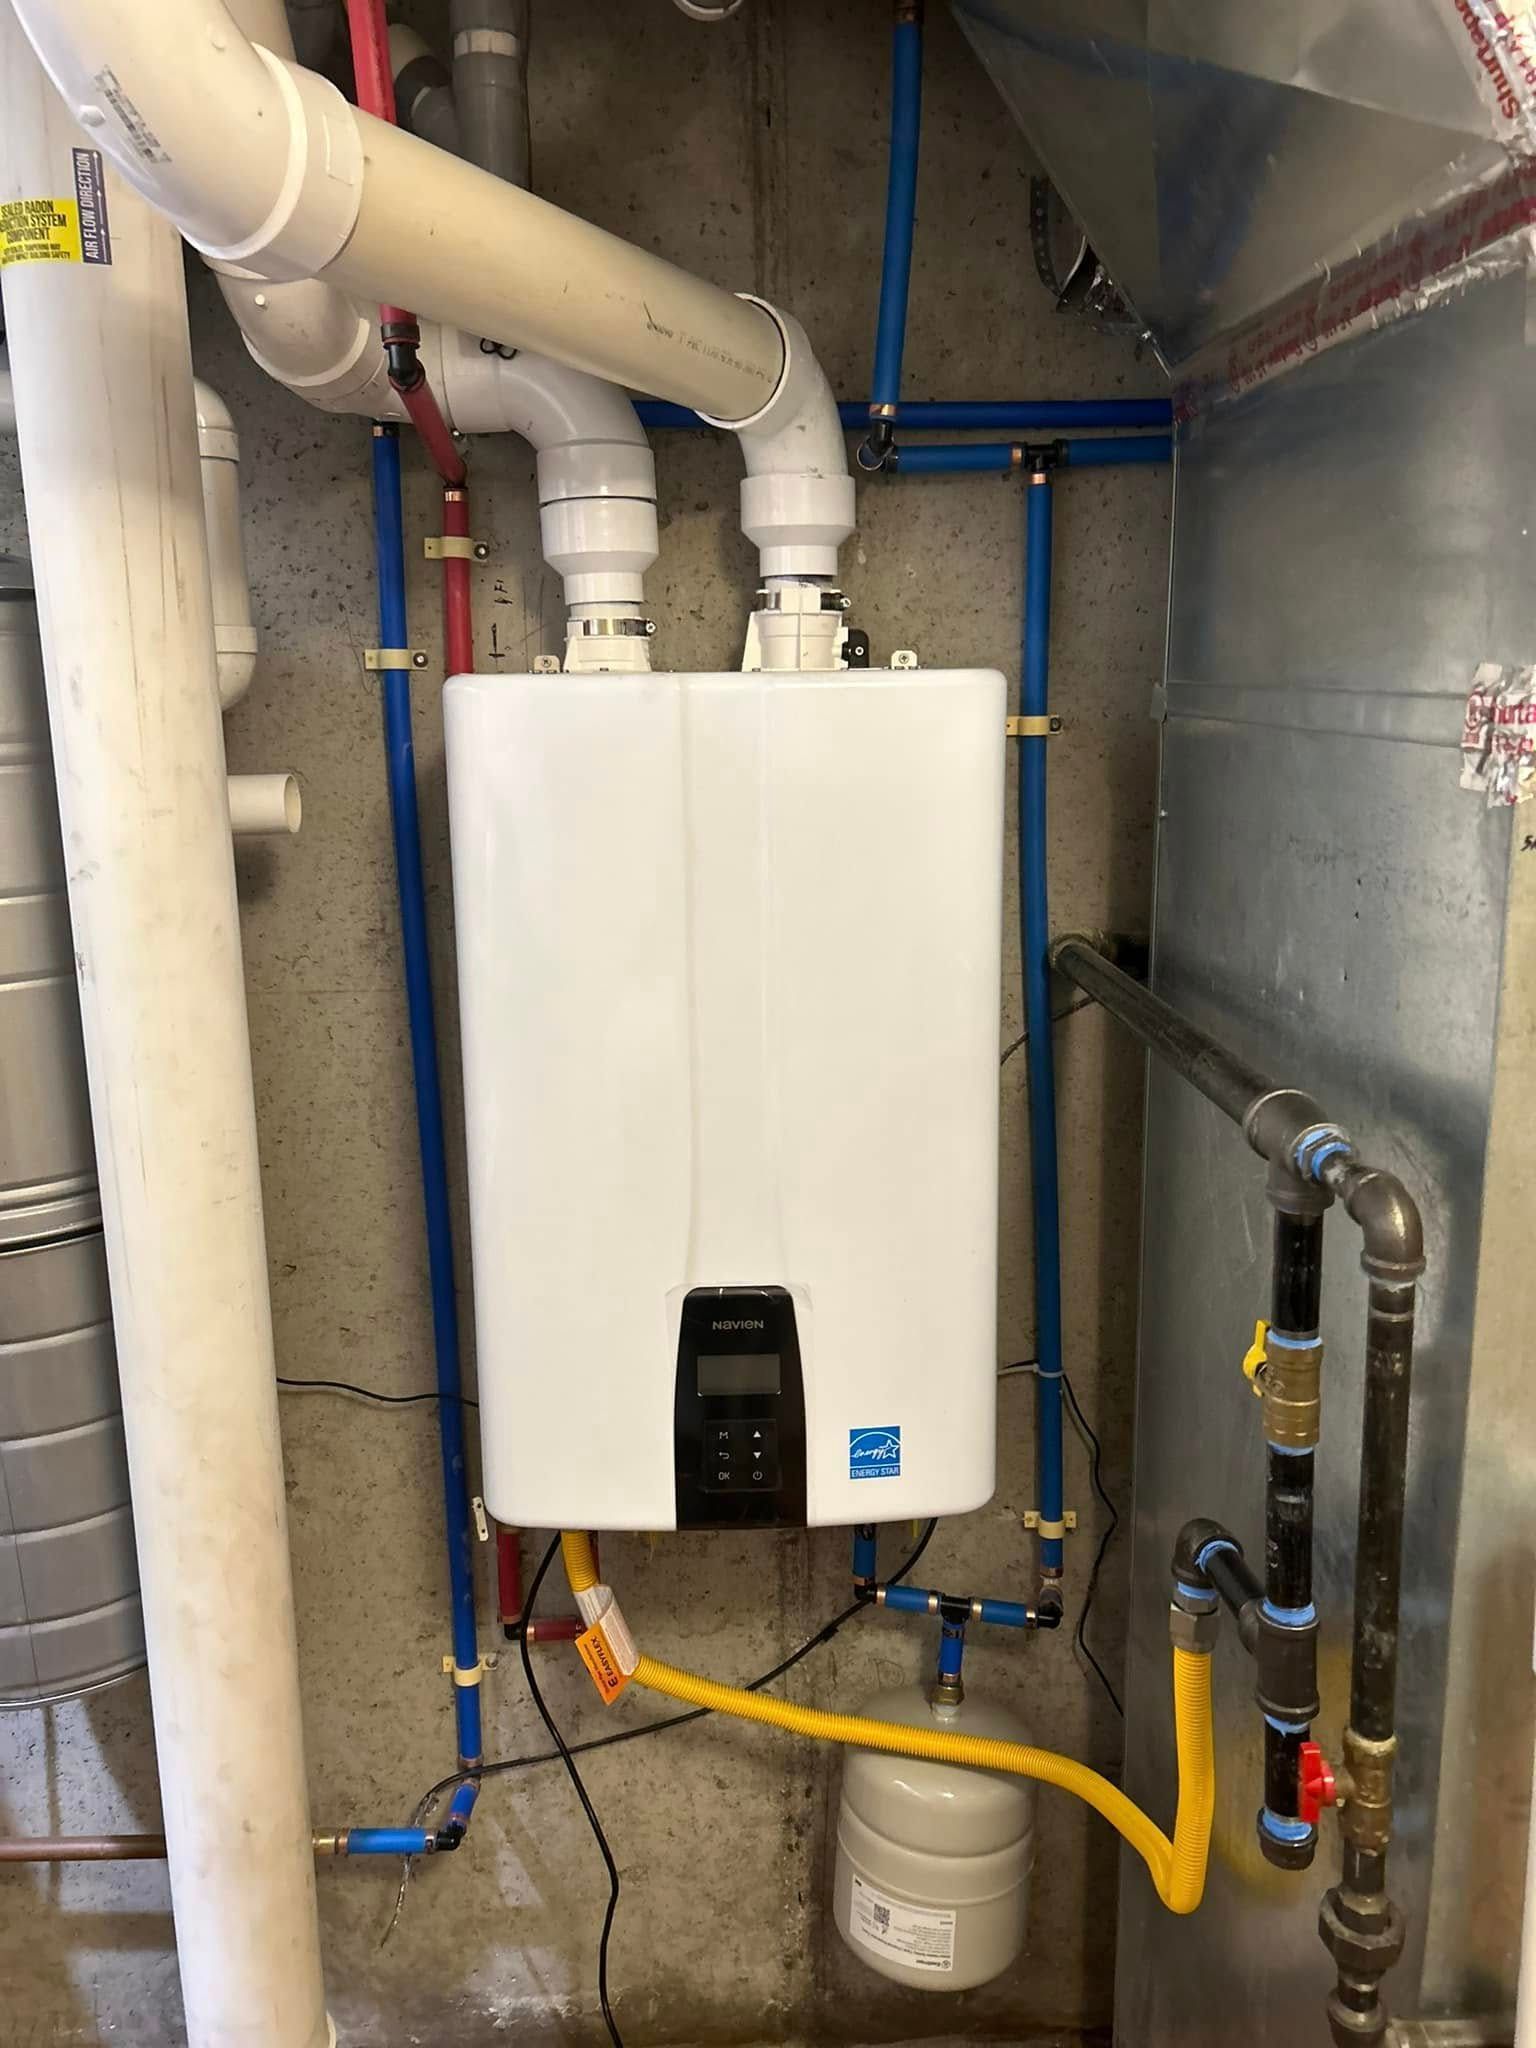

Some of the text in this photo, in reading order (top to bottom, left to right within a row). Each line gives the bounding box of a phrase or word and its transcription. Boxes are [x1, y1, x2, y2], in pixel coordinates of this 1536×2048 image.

[24, 199, 54, 214] RADON
[76, 152, 99, 259] AIR FLOW DIRECTION
[30, 213, 67, 228] SYSTEM
[719, 1431, 729, 1440] M
[718, 1471, 730, 1480] OK
[851, 1466, 899, 1478] ENERGY STAR
[590, 1635, 615, 1677] EASYFLEX
